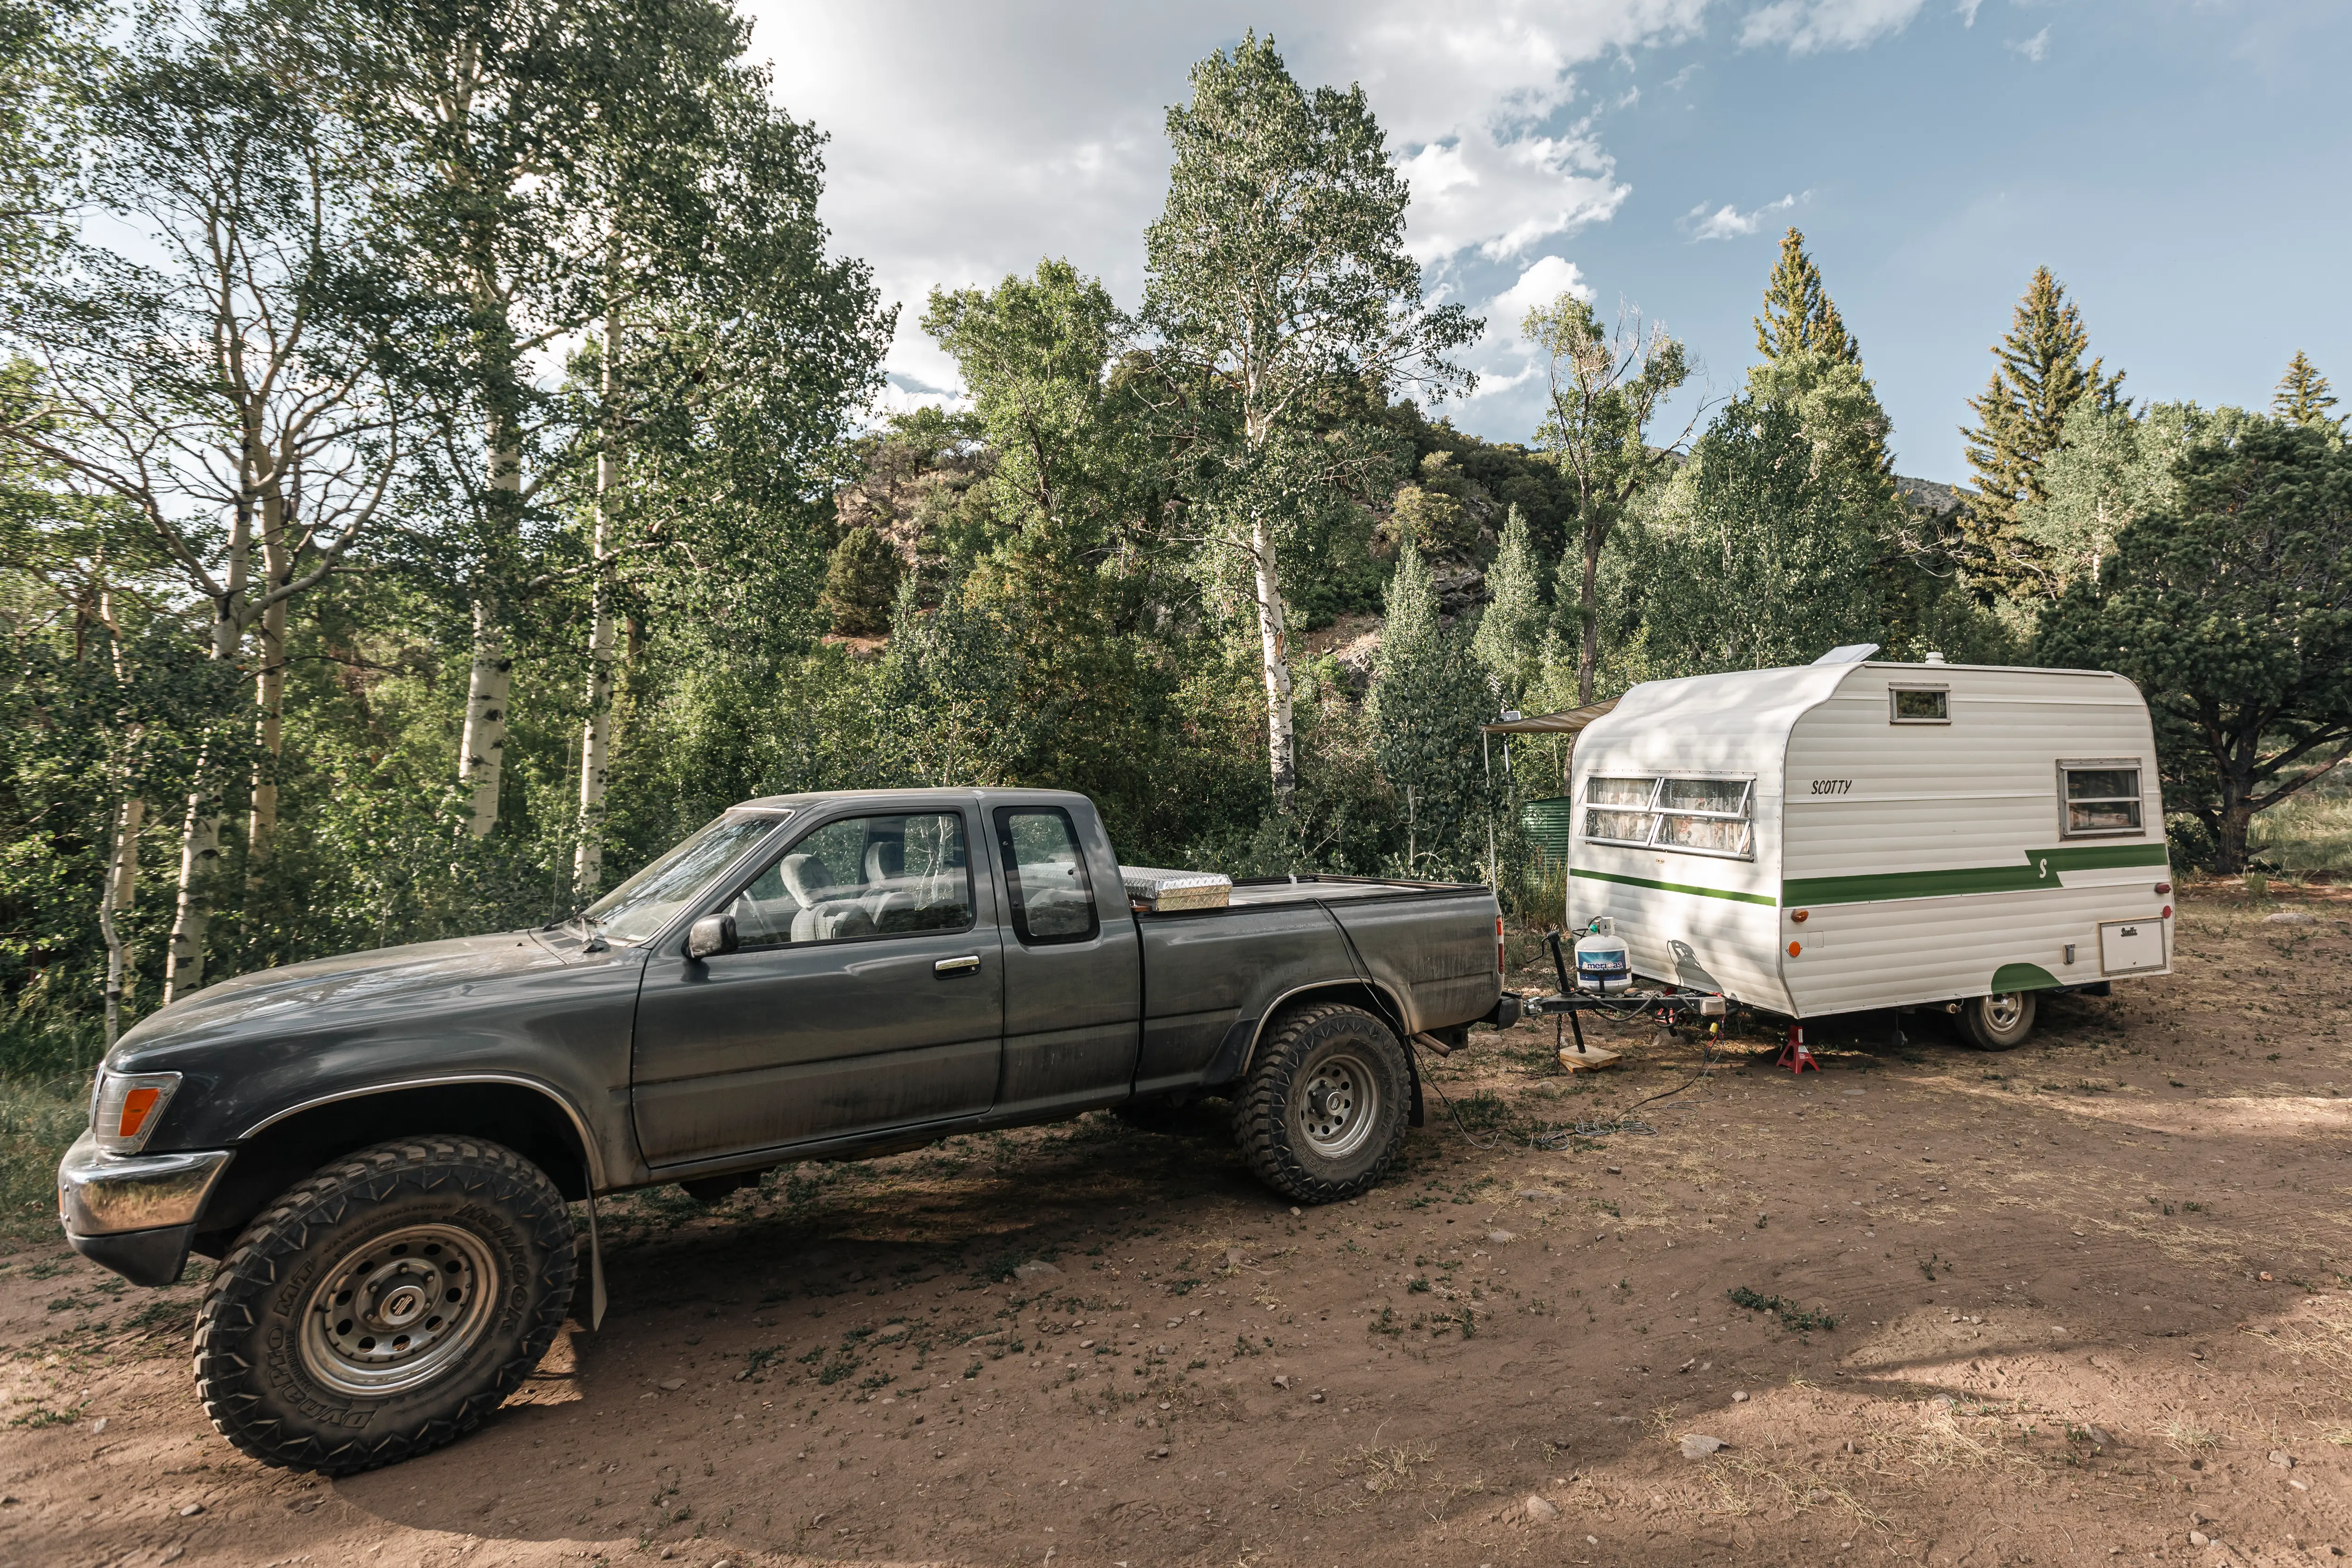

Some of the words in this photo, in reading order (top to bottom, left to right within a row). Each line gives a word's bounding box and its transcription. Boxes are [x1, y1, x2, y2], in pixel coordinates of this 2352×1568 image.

[1811, 779, 1852, 795] SCOTTY
[2039, 858, 2047, 878] S
[1582, 961, 1622, 970] AmeriGas
[273, 1258, 314, 1317] MT
